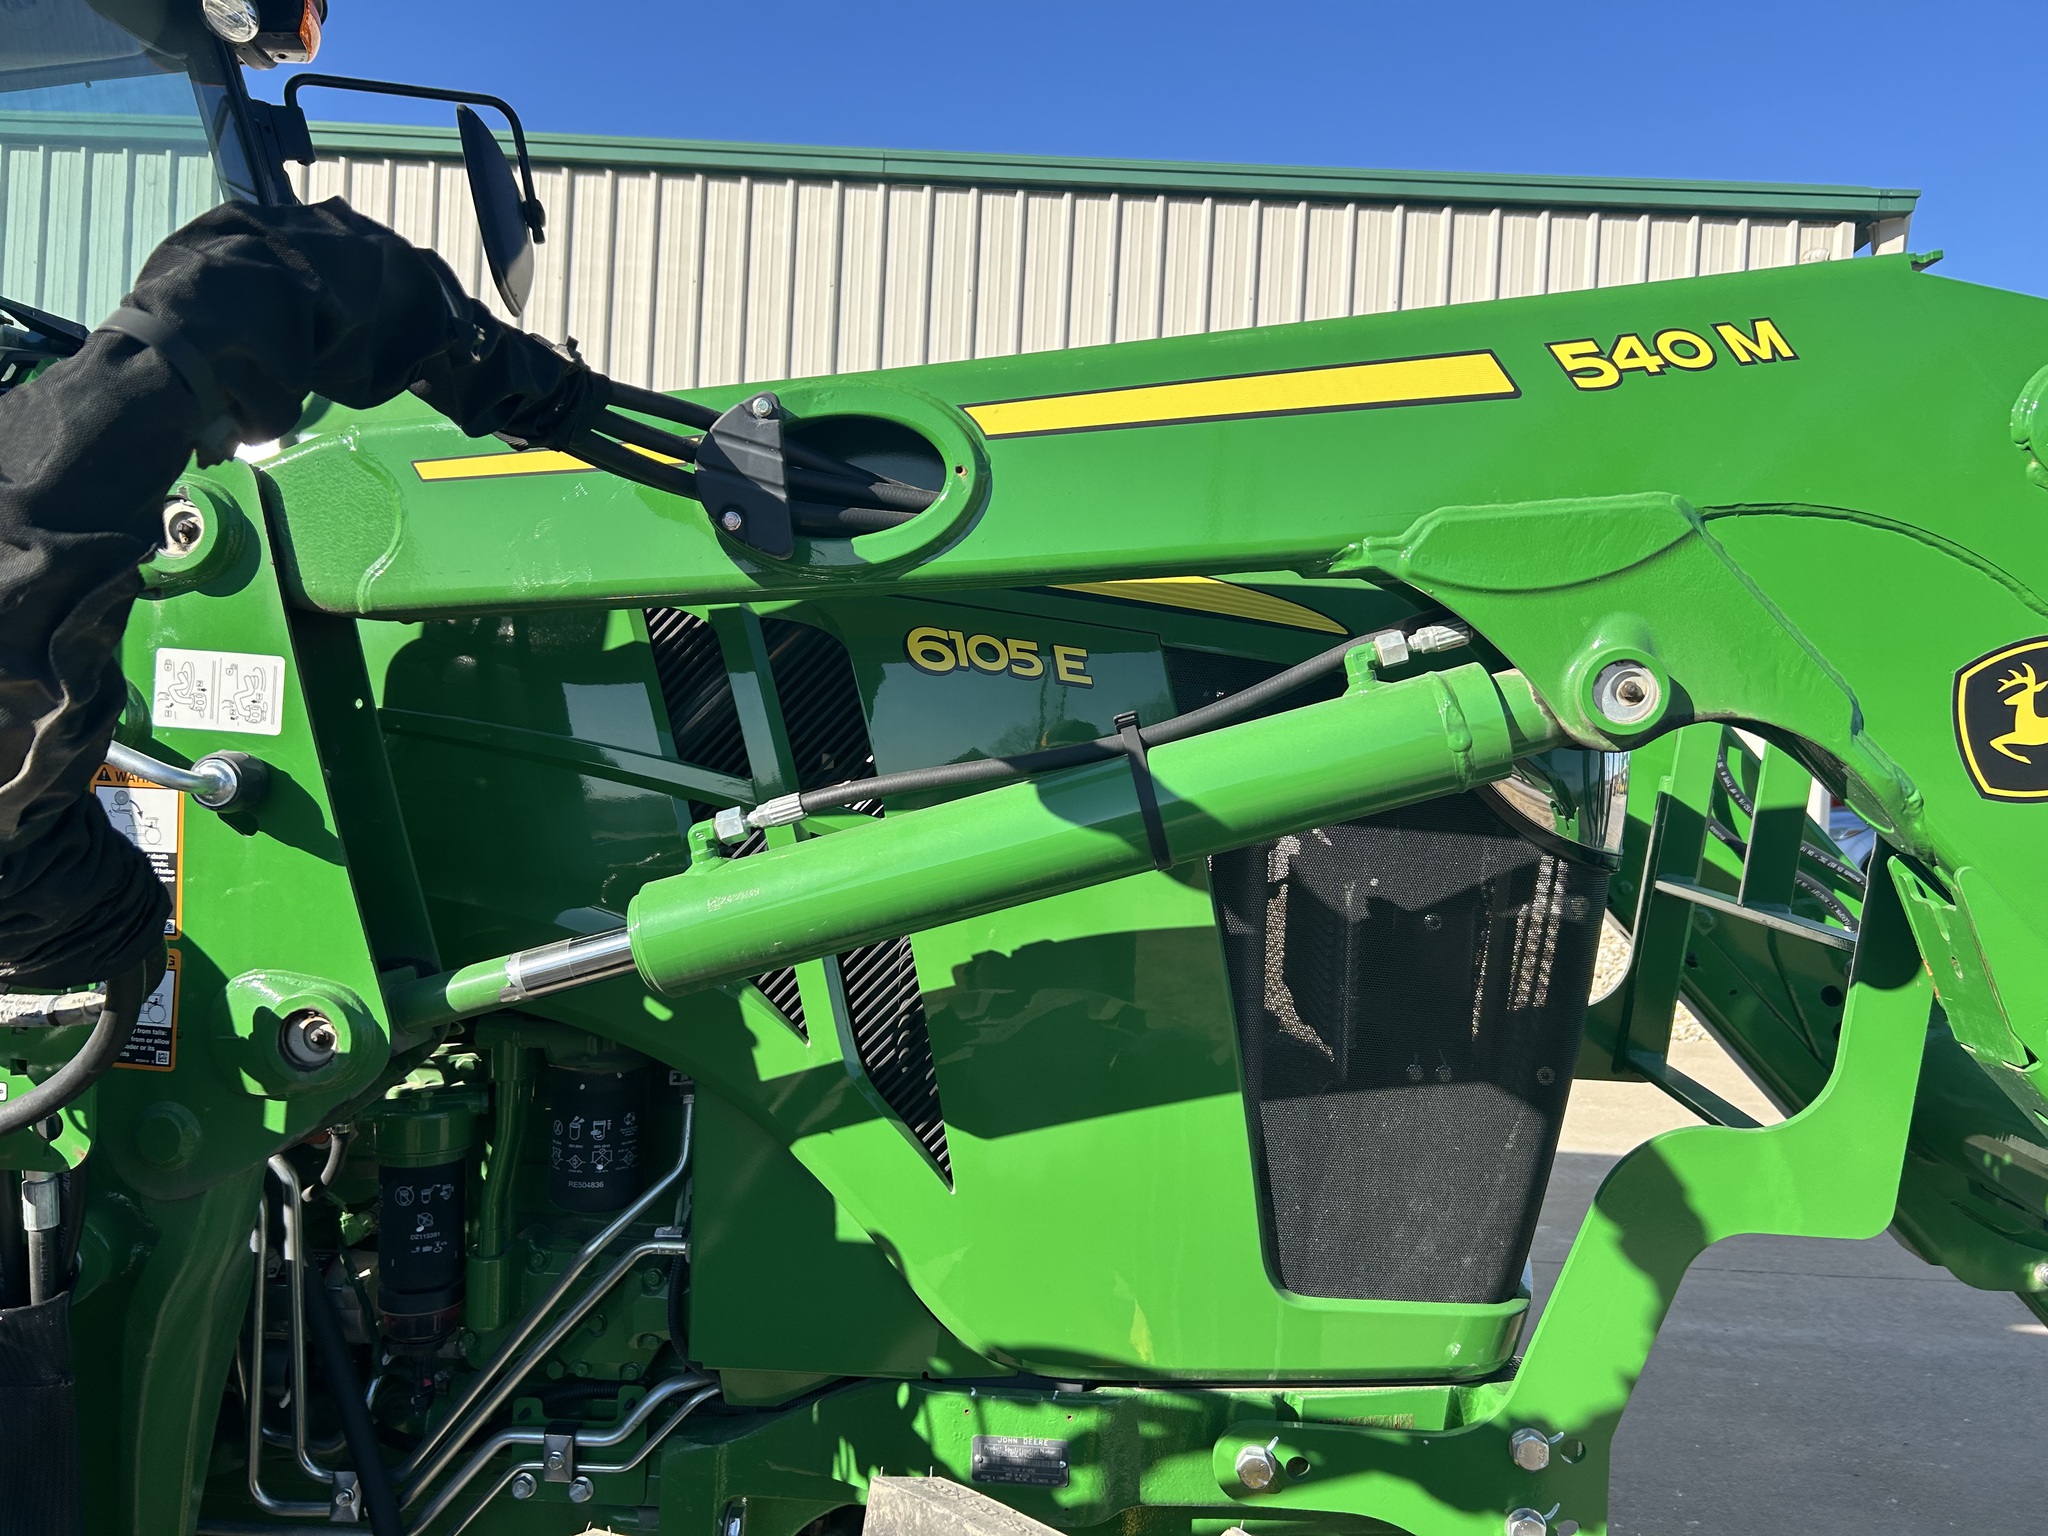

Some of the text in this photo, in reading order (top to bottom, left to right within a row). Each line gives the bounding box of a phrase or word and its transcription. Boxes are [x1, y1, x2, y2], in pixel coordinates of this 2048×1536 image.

[1548, 318, 1795, 390] 540 M
[905, 626, 1093, 687] 6105 E
[997, 1436, 1049, 1446] JOHN DEERE
